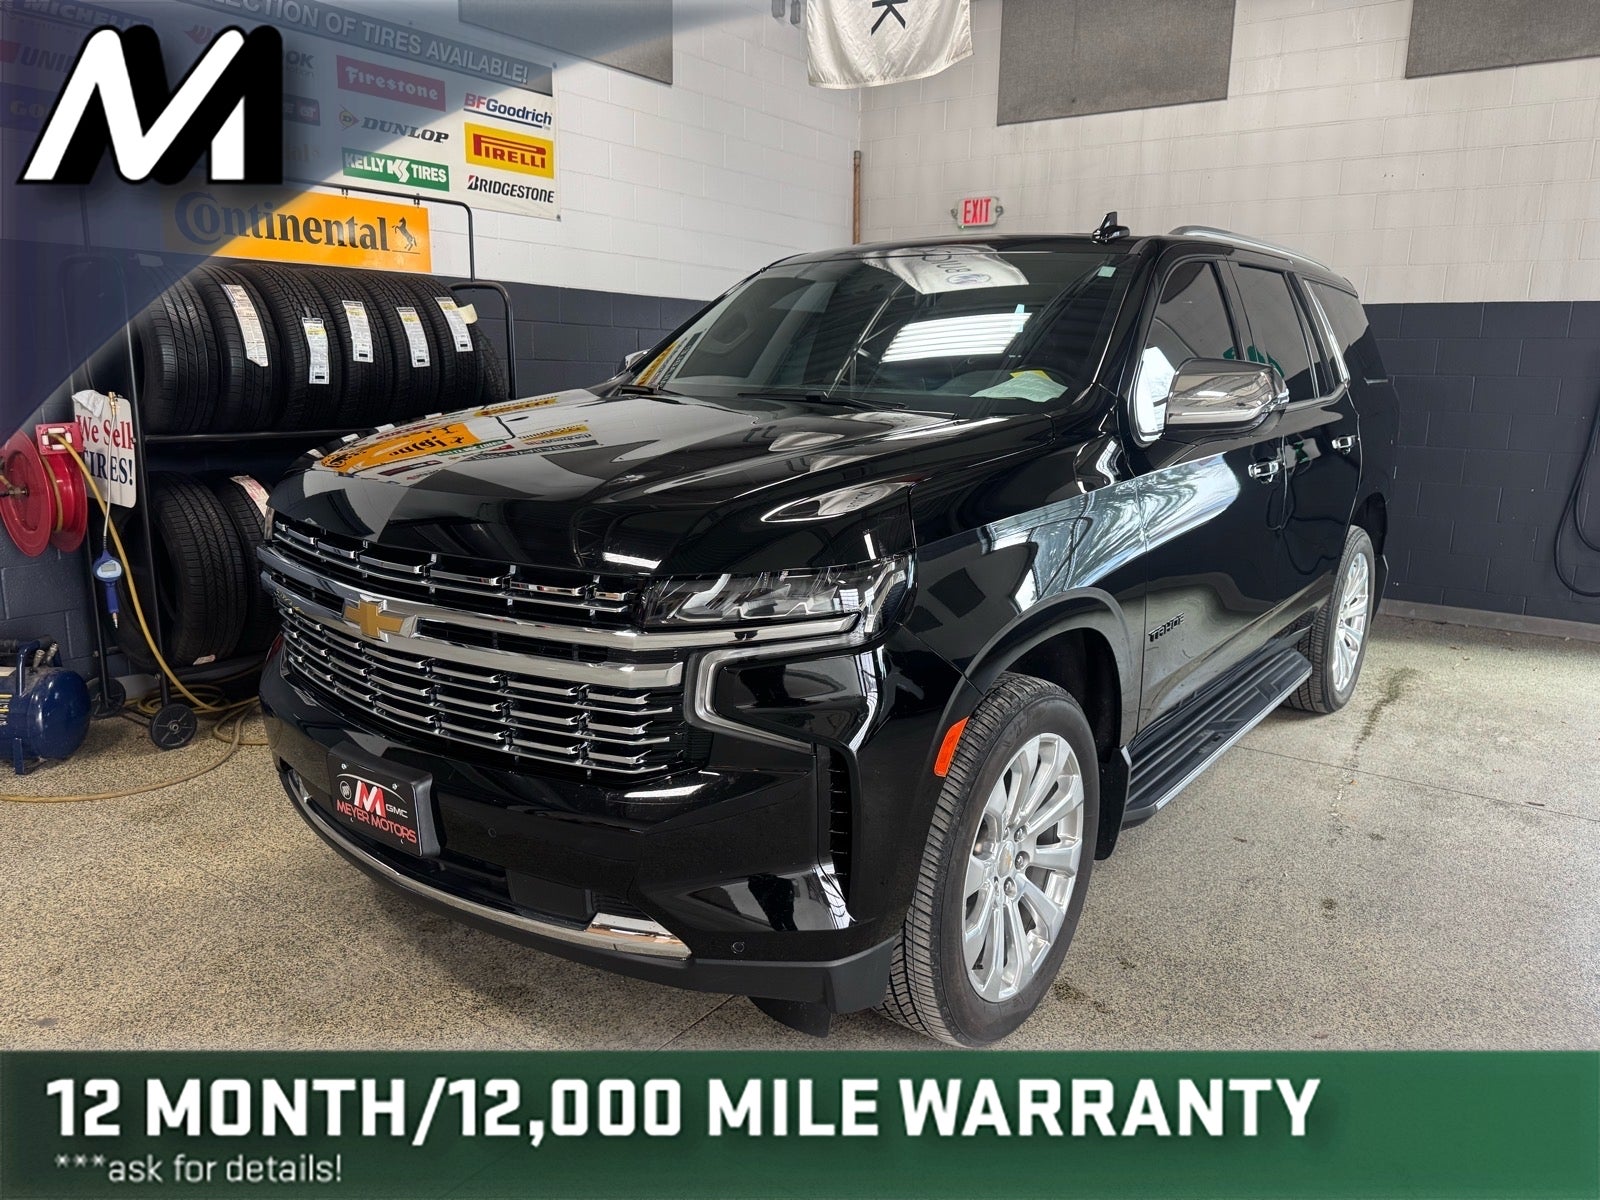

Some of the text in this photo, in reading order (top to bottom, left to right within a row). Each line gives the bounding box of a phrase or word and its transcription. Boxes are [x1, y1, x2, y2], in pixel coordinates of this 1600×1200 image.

[325, 12, 357, 36] OF
[362, 23, 422, 54] TIRES
[426, 40, 528, 84] AVAILABLE!
[345, 66, 439, 100] Firestone
[464, 92, 552, 126] BFGoodrich
[361, 116, 449, 144] DUNLOP
[473, 133, 546, 168] PIRELLI
[344, 153, 385, 173] KELLY
[411, 163, 447, 183] TIRES
[467, 175, 554, 203] BRIDGESTONE
[175, 191, 390, 252] Continental
[963, 198, 991, 224] EXIT
[76, 415, 133, 449] We Sell
[337, 799, 417, 844] MEYER MOTORS
[385, 803, 408, 819] GMC
